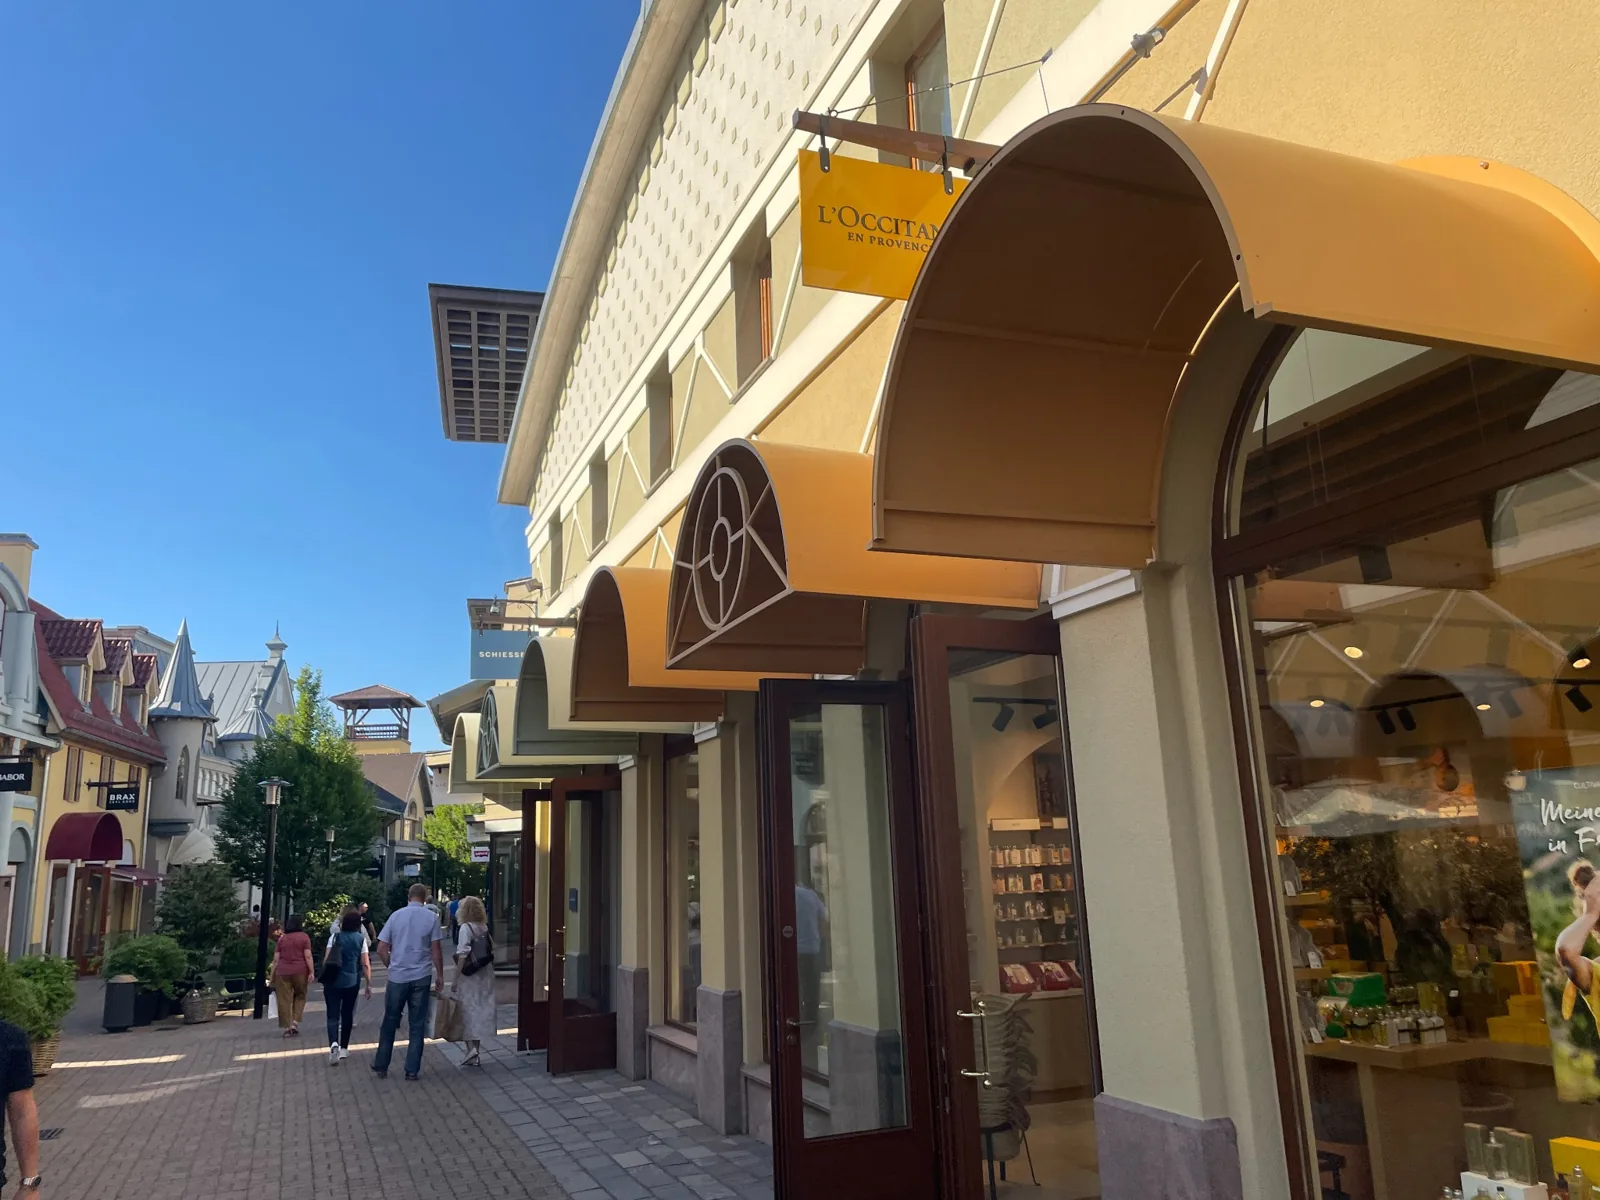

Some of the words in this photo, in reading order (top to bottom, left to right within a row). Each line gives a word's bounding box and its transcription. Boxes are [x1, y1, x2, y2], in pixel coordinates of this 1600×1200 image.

[847, 232, 864, 242] EN
[869, 235, 932, 253] PROVENC
[109, 793, 136, 801] BRAX
[1549, 838, 1567, 854] in
